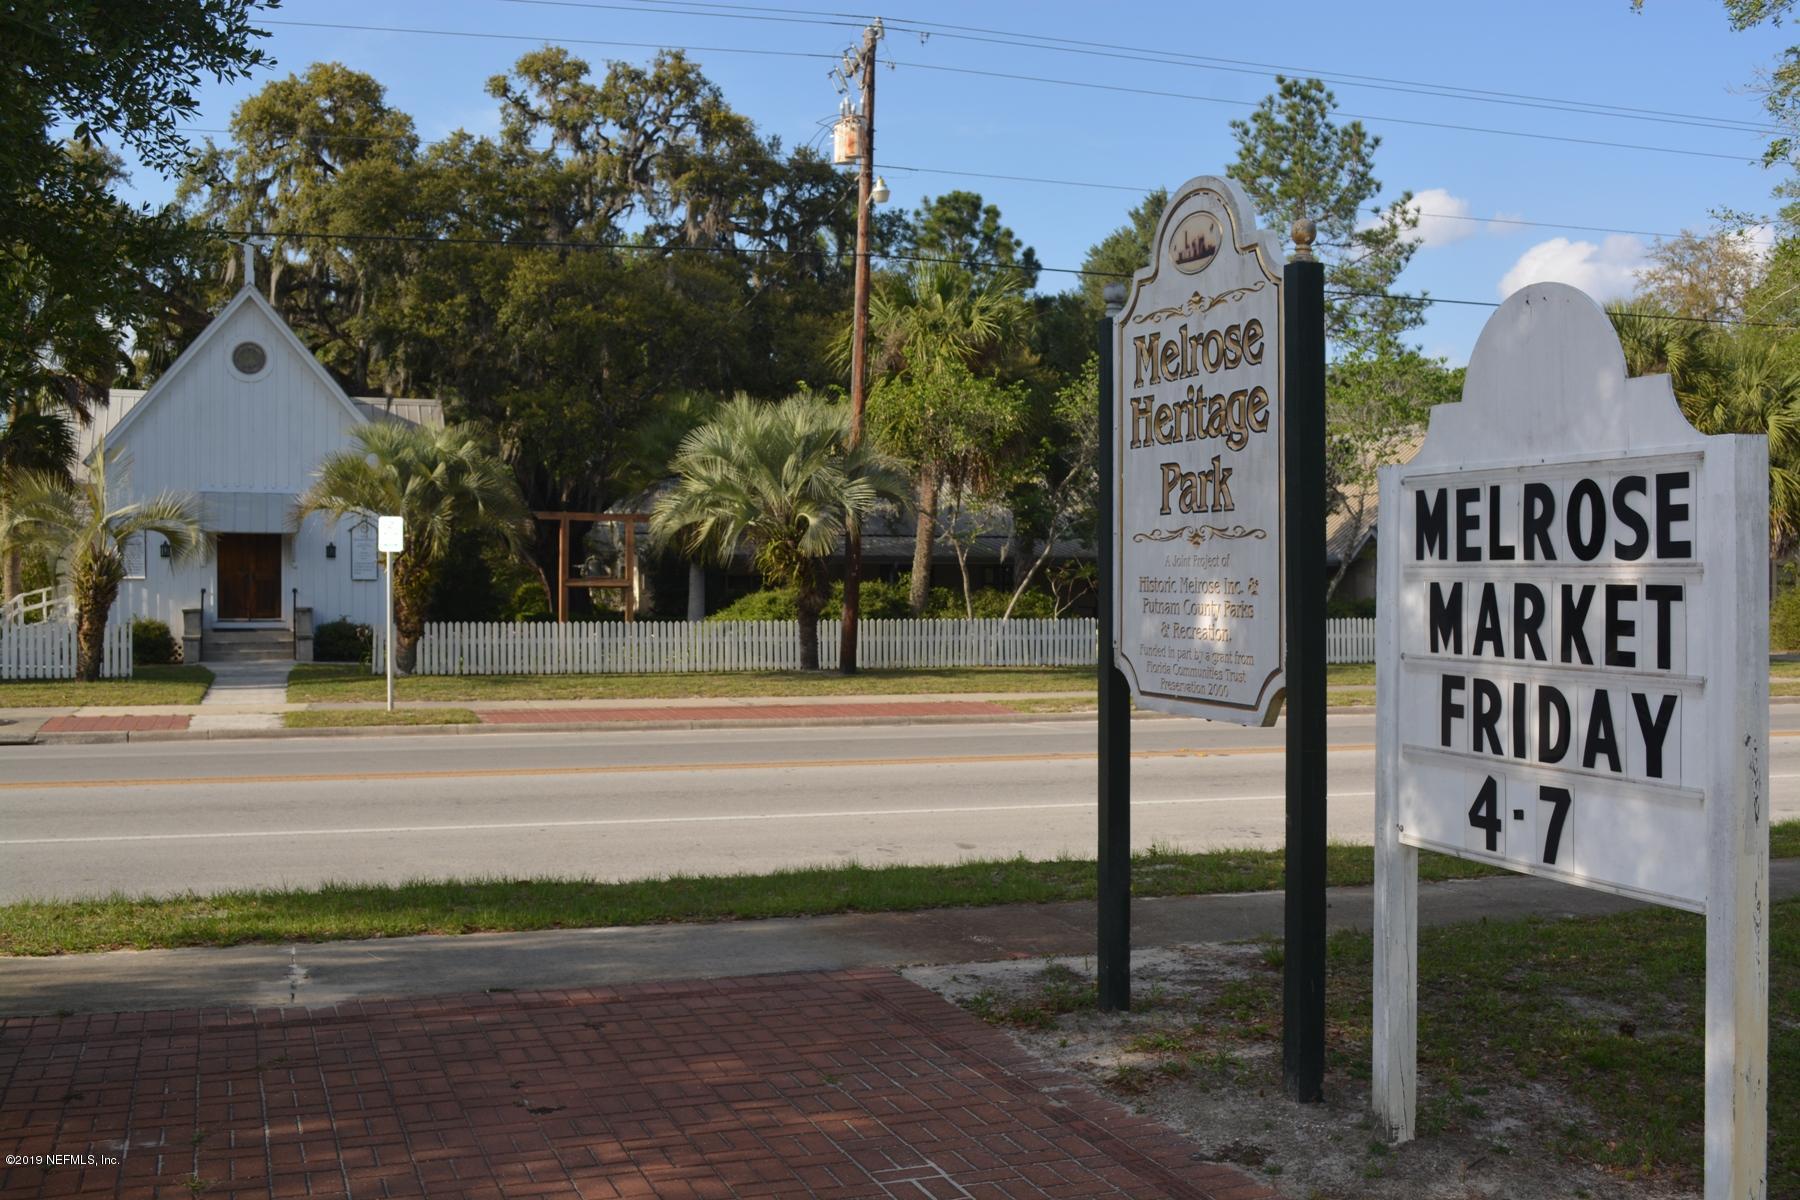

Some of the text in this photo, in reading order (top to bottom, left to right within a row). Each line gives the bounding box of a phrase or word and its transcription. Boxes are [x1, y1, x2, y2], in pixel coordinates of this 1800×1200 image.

[1133, 318, 1264, 389] Melrose
[1130, 385, 1269, 451] Heritage
[1160, 455, 1234, 515] Park
[1415, 472, 1692, 562] MELROSE
[1164, 553, 1231, 569] A Joint Project of
[1138, 576, 1259, 595] Historic Melrose Inc. &
[1142, 598, 1254, 621] Putnam County Parks
[1161, 622, 1170, 638] &
[1429, 582, 1683, 670] MARKET
[1139, 644, 1254, 665] Funded in part by a grant from
[1146, 661, 1170, 674] Florida
[1173, 663, 1223, 680] Communities
[1160, 678, 1229, 697] Preservation 2000
[1441, 674, 1678, 779] FRIDAY
